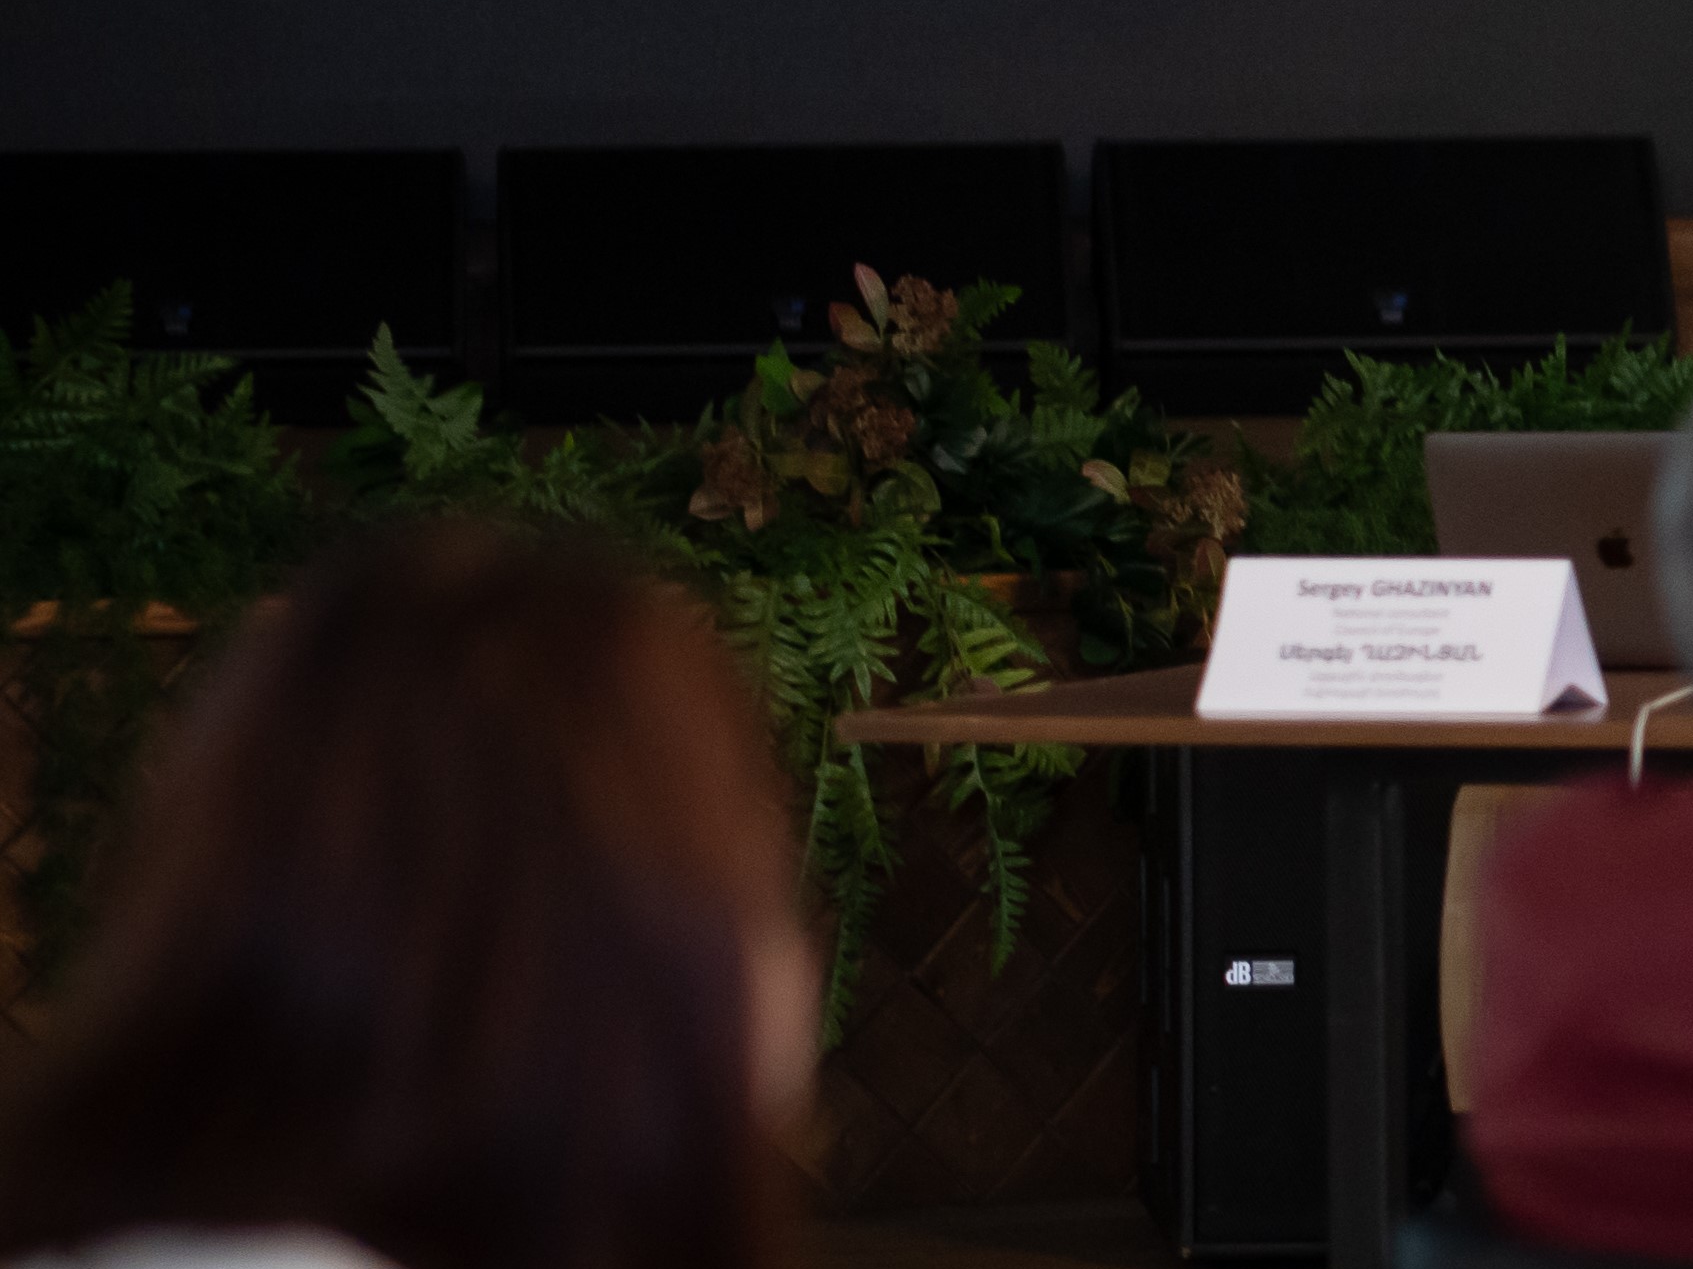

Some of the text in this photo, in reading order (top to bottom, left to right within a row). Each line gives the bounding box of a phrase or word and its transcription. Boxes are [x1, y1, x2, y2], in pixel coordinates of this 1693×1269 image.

[1296, 579, 1493, 600] Sergey GHAZINYAN
[1225, 960, 1252, 985] dB
